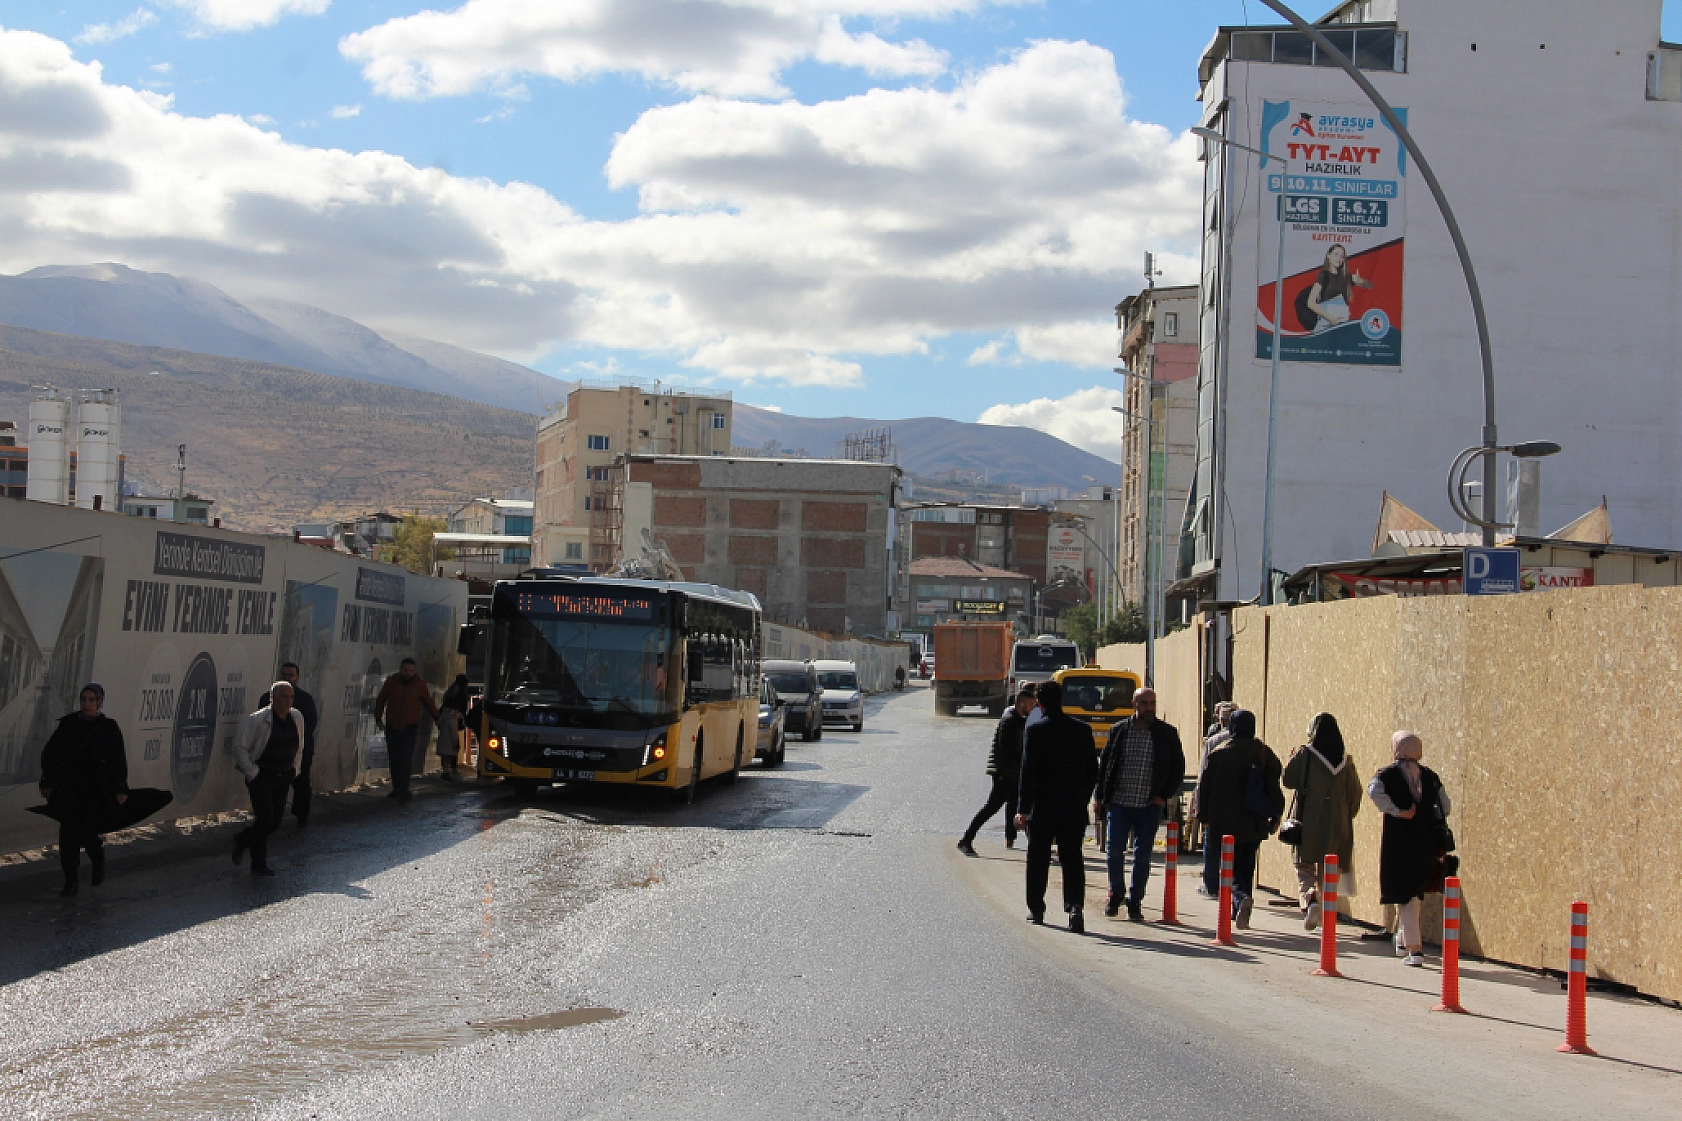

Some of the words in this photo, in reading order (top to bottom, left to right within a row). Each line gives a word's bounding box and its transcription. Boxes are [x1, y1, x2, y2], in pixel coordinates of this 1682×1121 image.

[1319, 115, 1374, 131] avrasya
[1287, 143, 1380, 164] TYT-AYT
[1306, 163, 1361, 175] HAZIRLIK
[1312, 180, 1331, 192] 11.
[1335, 181, 1393, 195] SINIFLAR
[1285, 197, 1320, 213] LGS
[1337, 214, 1381, 225] SINIFLAR
[1469, 553, 1490, 578] D
